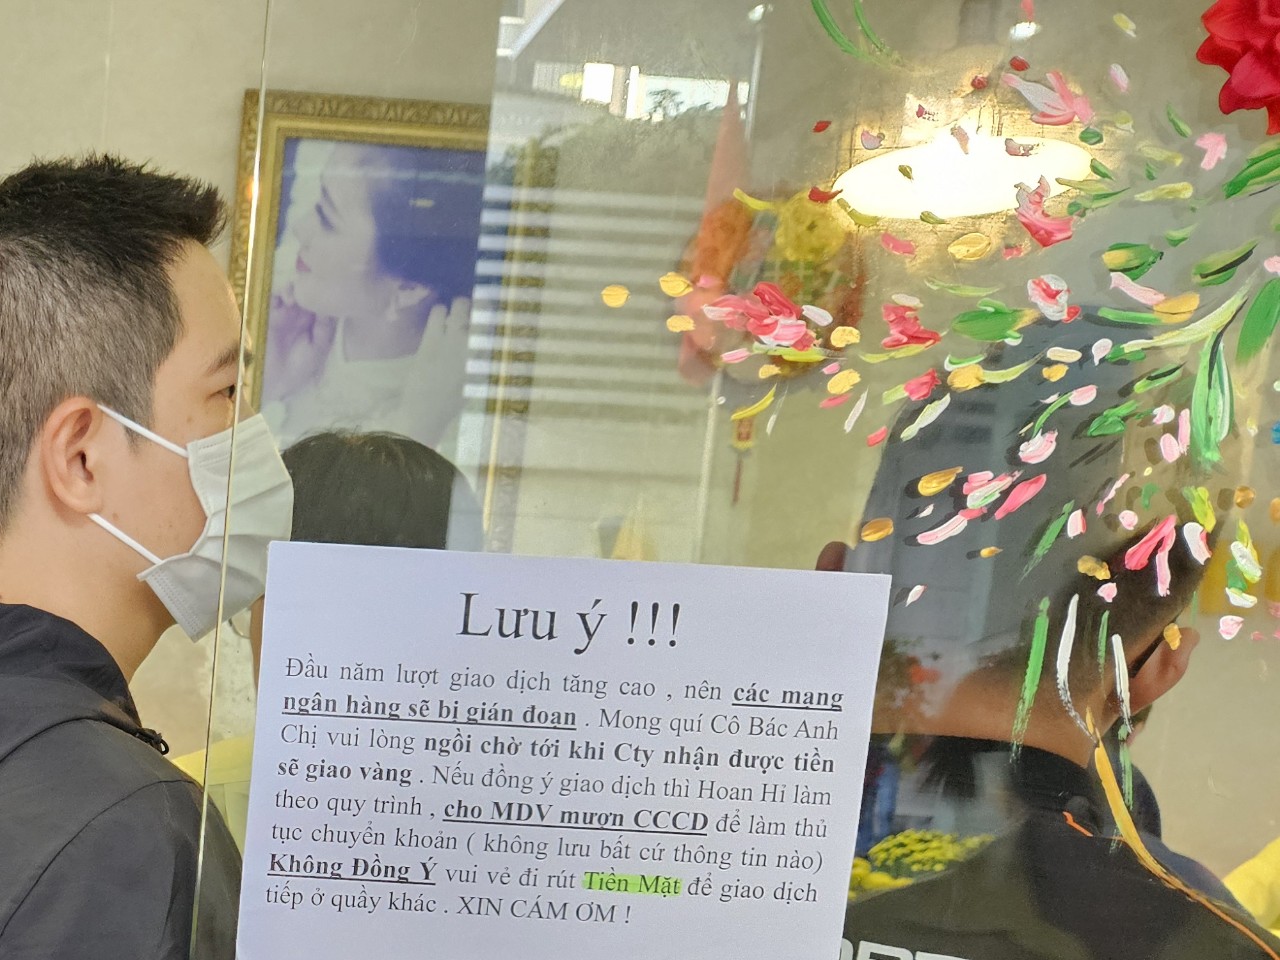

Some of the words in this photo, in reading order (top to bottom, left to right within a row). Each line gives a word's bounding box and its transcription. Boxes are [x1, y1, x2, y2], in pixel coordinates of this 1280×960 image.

[456, 592, 558, 641] Lưu
[573, 598, 608, 656] ý
[627, 600, 681, 648] !!!
[285, 652, 328, 679] Đầu
[339, 662, 384, 682] năm
[396, 663, 439, 689] lượt
[449, 666, 495, 692] giao
[506, 669, 550, 694] dịch
[562, 674, 609, 700] tăng
[619, 681, 656, 697] cao
[684, 679, 721, 701] nên
[733, 682, 770, 703] các
[780, 690, 845, 713] mạng
[282, 691, 337, 718] ngân
[345, 694, 401, 722] hàng
[408, 699, 430, 718] sẽ
[438, 699, 459, 722] bị
[465, 701, 514, 728] gián
[522, 704, 576, 729] đoạn
[598, 708, 663, 736] Mong
[669, 713, 704, 738] quí
[710, 714, 740, 735] Cô
[747, 716, 788, 738] Bác
[792, 719, 838, 740] Anh
[280, 723, 317, 749] Chị
[326, 727, 360, 747] vui
[369, 727, 416, 755] lòng
[423, 727, 472, 758] ngồi
[480, 735, 523, 756] chờ
[530, 738, 560, 758] tới
[568, 739, 605, 761] khi
[613, 742, 655, 768] Cty
[662, 745, 719, 771] nhận
[728, 748, 785, 775] được
[793, 746, 834, 773] tiền
[277, 758, 300, 777] sẽ
[305, 758, 352, 783] giao
[359, 761, 413, 788] vàng
[432, 760, 474, 786] Nếu
[481, 762, 534, 795] đồng
[539, 771, 554, 796] ý
[558, 772, 605, 797] giao
[611, 774, 656, 799] dịch
[663, 777, 690, 798] thì
[696, 779, 753, 802] Hoan
[792, 784, 831, 806] làm
[275, 788, 319, 810] theo
[327, 797, 367, 818] quy
[374, 794, 422, 816] trình
[444, 799, 483, 819] cho
[490, 800, 554, 822] MDV
[559, 810, 624, 829] mượn
[633, 809, 709, 831] CCCD
[715, 808, 741, 834] để
[747, 814, 786, 836] làm
[795, 817, 827, 838] thủ
[271, 823, 303, 845] tục
[311, 820, 385, 849] chuyển
[394, 827, 457, 850] khoản
[466, 832, 476, 856] (
[483, 832, 549, 861] không
[557, 836, 591, 858] lưu
[600, 834, 631, 860] bất
[639, 842, 666, 862] cứ
[673, 843, 733, 871] thông
[741, 847, 767, 868] tin
[775, 849, 823, 875] nào)
[265, 880, 304, 910] tiếp
[310, 887, 326, 907] ở
[331, 884, 382, 914] quầy
[387, 891, 437, 913] khác
[456, 896, 504, 917] XIN
[510, 894, 569, 921] CÁM
[575, 901, 616, 923] ƠM
[624, 905, 631, 924] !
[268, 852, 344, 881] Không
[350, 853, 411, 885] Đồng
[419, 856, 439, 881] Ý
[445, 864, 478, 884] vui
[487, 866, 511, 886] vẻ
[518, 867, 539, 887] đi
[546, 869, 576, 889] rút
[583, 866, 629, 892] Tiền
[638, 874, 681, 898] Mặt
[687, 871, 713, 897] để
[719, 878, 765, 903] giao
[773, 881, 817, 906] dịch
